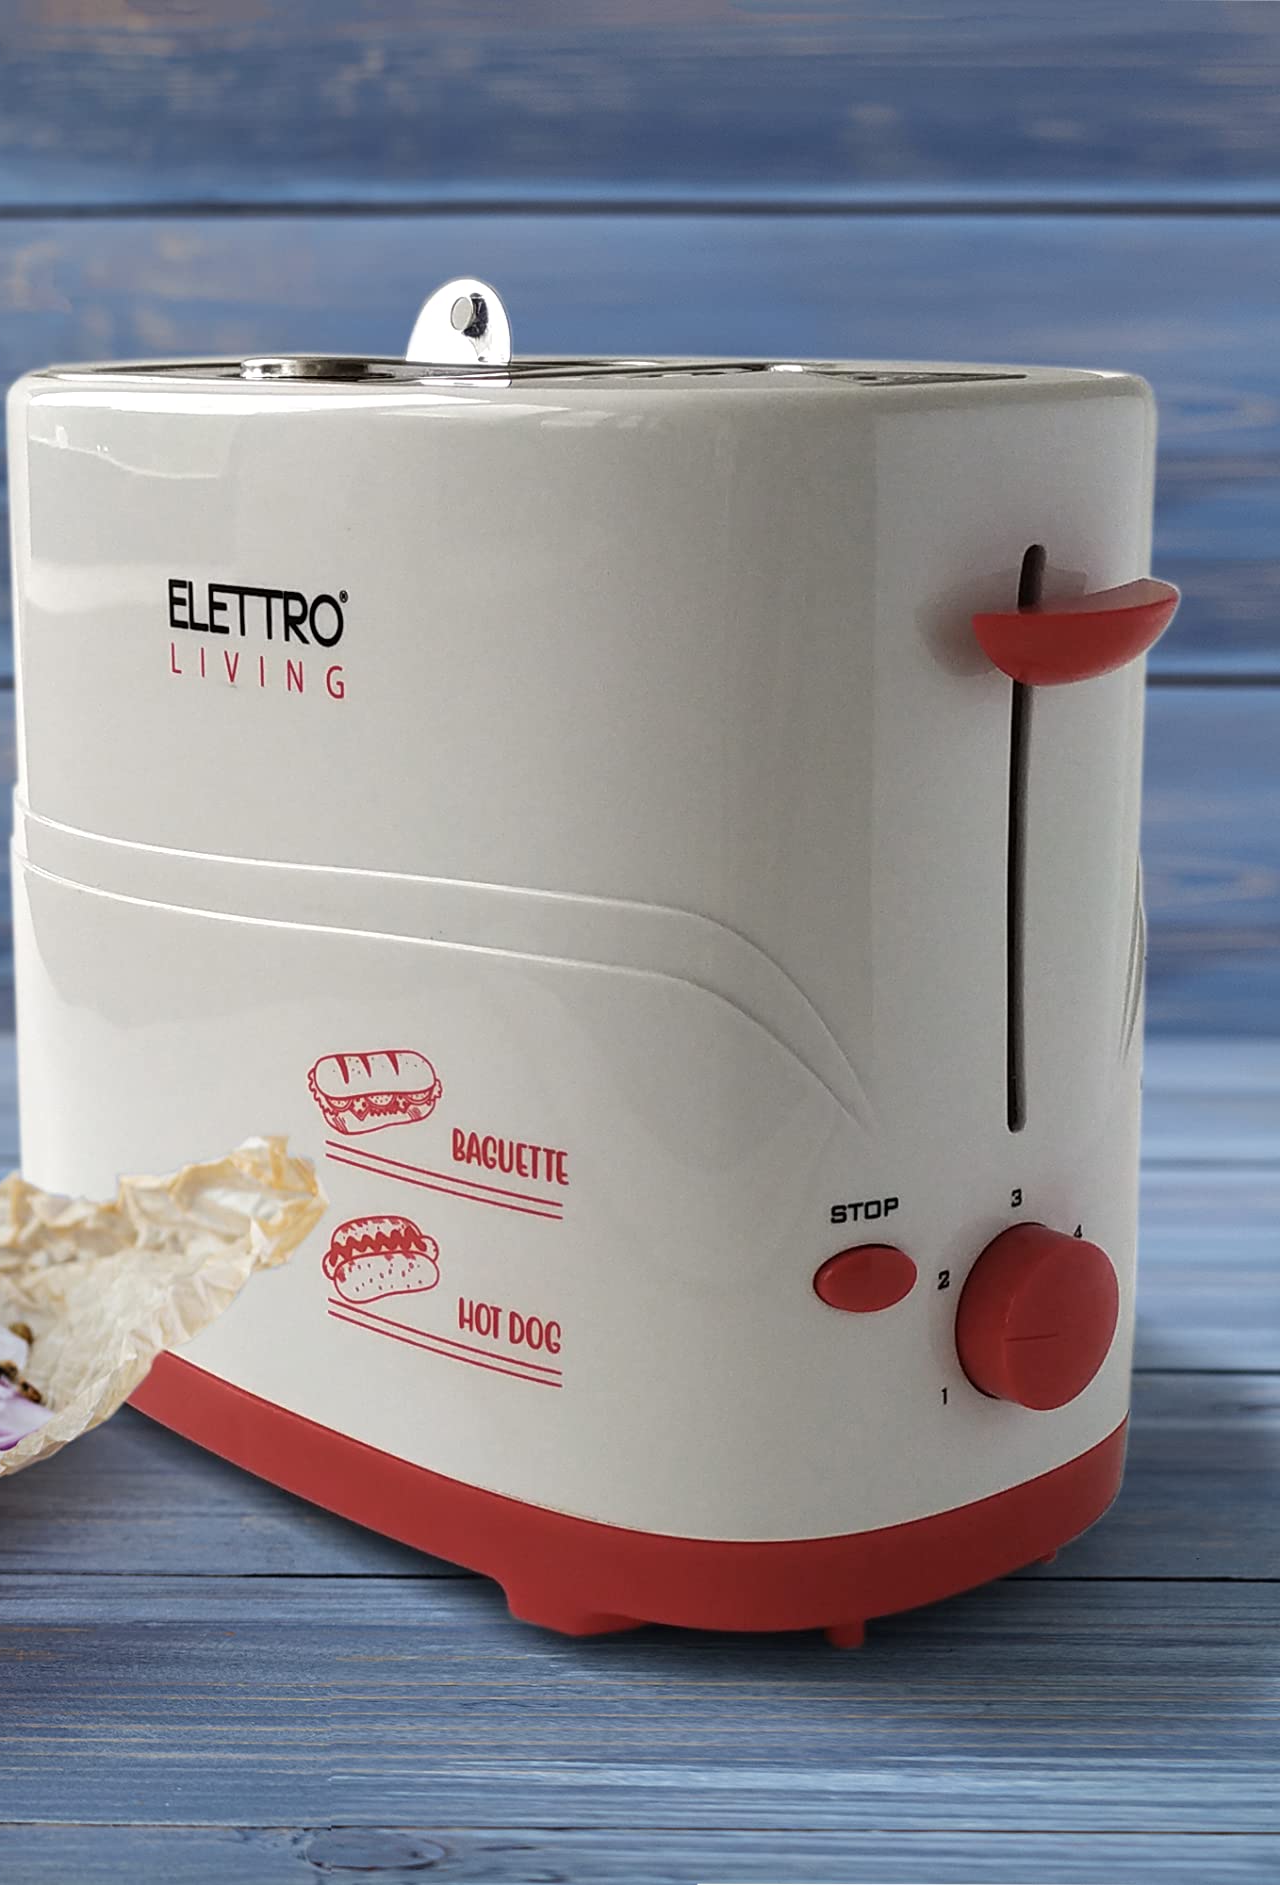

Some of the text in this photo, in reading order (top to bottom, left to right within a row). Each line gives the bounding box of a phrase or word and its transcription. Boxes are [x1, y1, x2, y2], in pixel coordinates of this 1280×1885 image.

[170, 642, 345, 699] LIVING
[452, 1127, 570, 1186] BAGUETTE
[830, 1196, 900, 1224] STOP
[1010, 1188, 1023, 1208] 3
[1073, 1224, 1083, 1239] 4
[937, 1269, 951, 1290] 2
[458, 1297, 562, 1354] HOT DOG
[940, 1387, 948, 1405] 1
